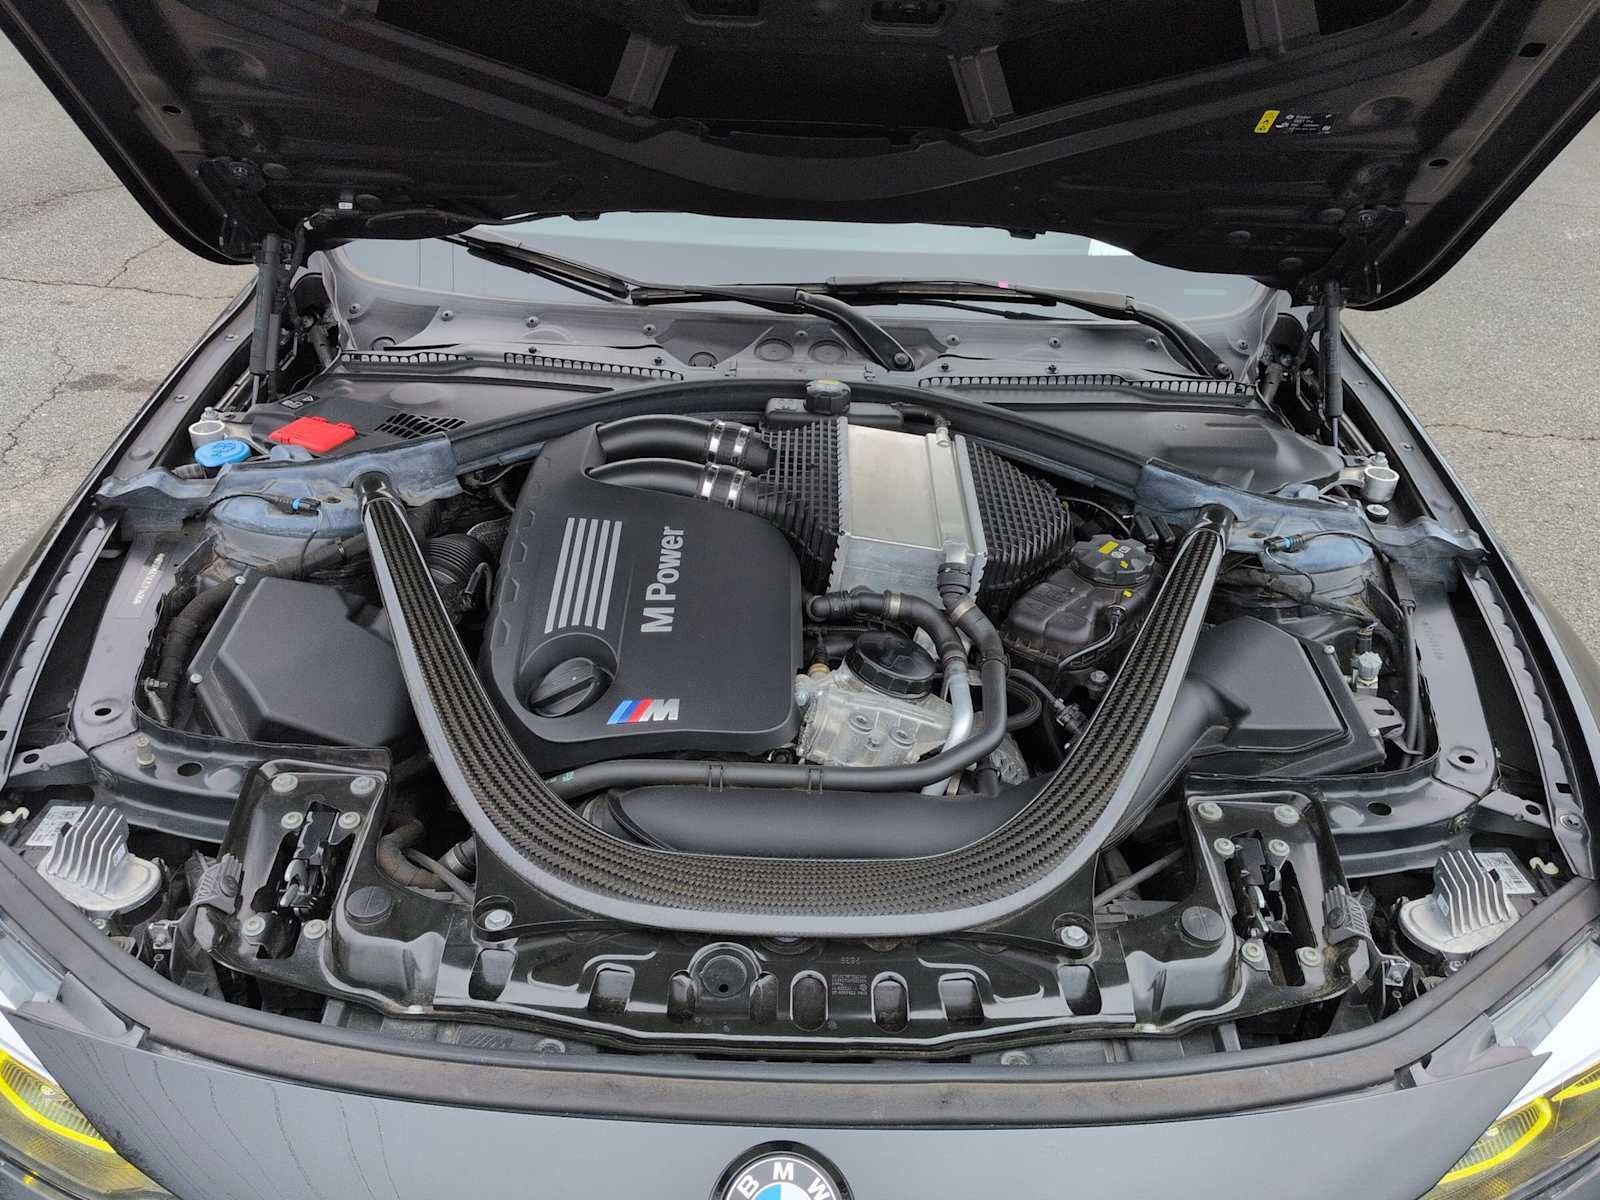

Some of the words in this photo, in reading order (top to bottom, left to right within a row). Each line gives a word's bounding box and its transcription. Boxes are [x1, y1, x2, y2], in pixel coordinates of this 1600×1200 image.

[645, 526, 685, 601] Power
[640, 607, 676, 633] M
[736, 1161, 831, 1200] BMW
